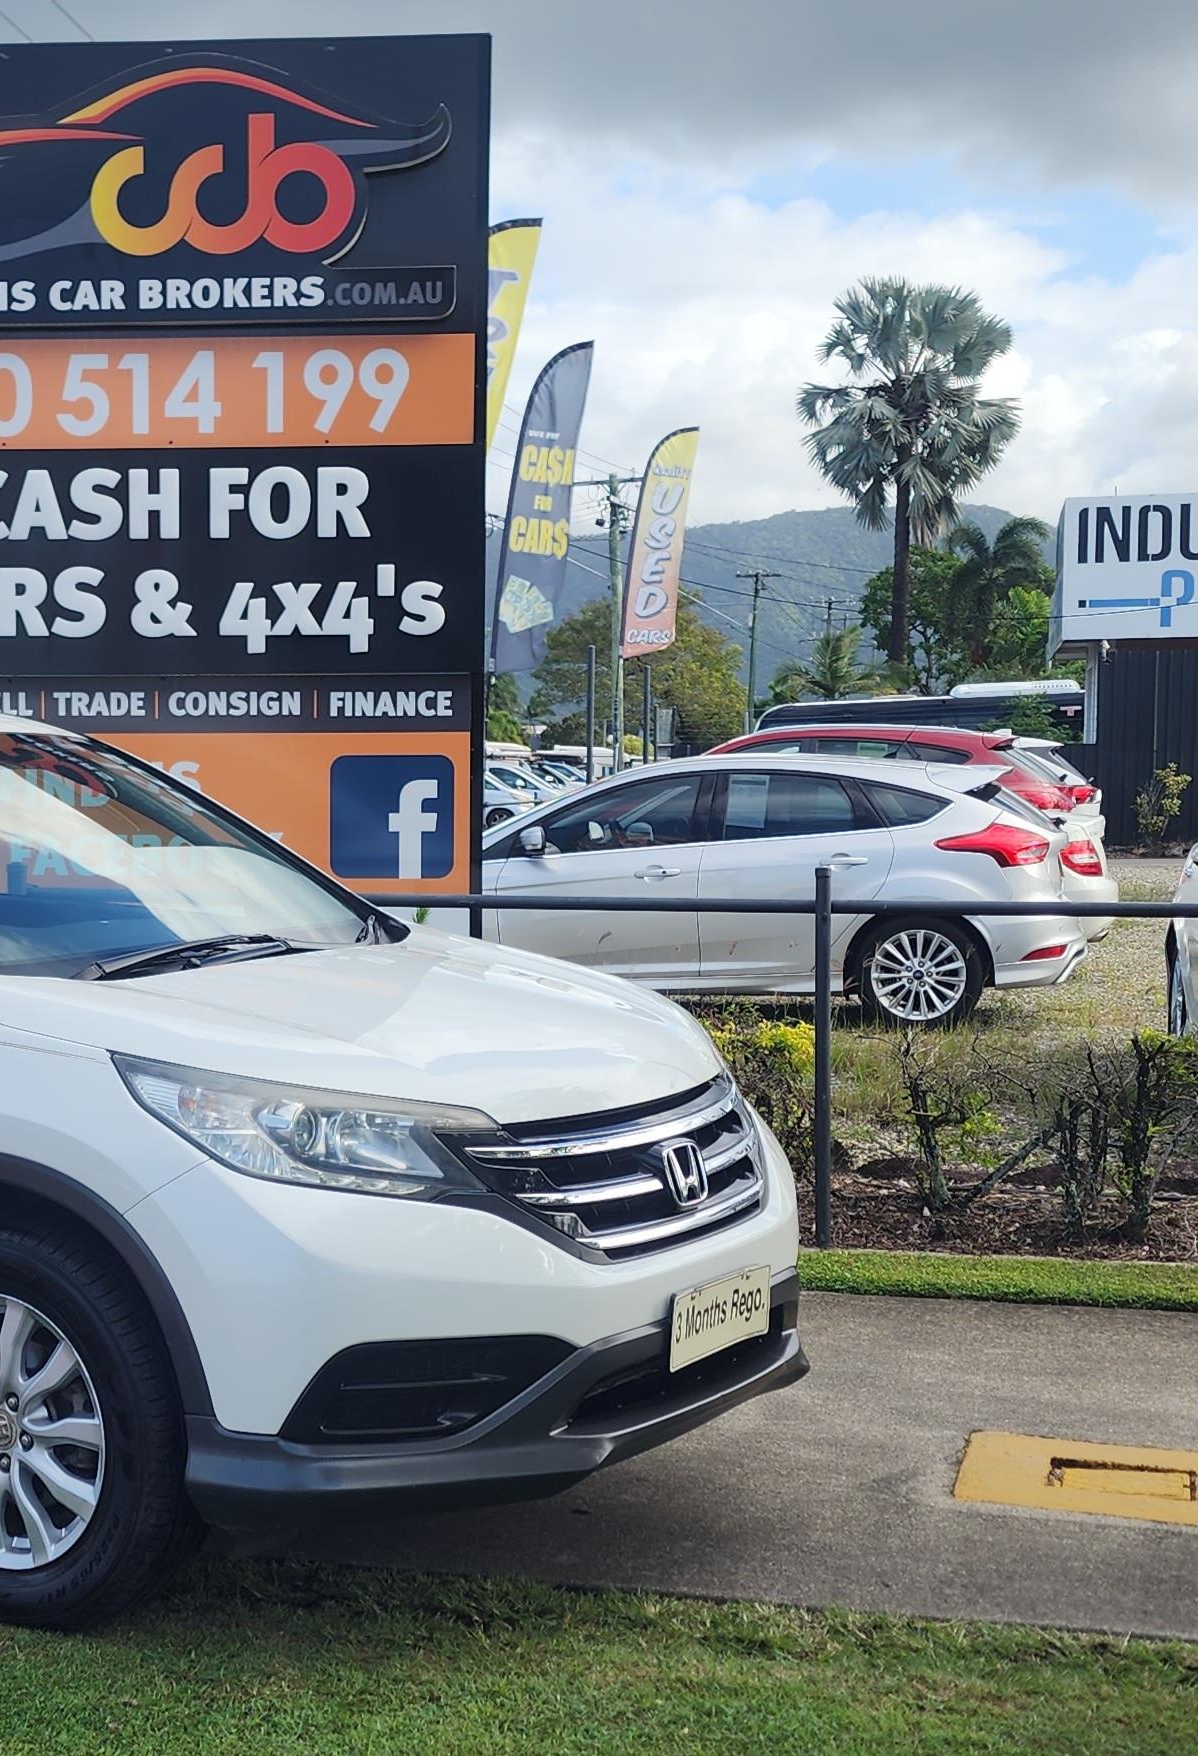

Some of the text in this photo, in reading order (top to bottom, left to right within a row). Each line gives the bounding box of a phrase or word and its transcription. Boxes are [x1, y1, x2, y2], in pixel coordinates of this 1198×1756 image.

[49, 280, 126, 311] CAR
[56, 351, 222, 437] 514
[252, 348, 410, 434] 199
[209, 466, 371, 540] FOR
[130, 569, 198, 638] &
[54, 691, 146, 718] TRADE
[168, 690, 301, 717] CONSIGN
[329, 690, 453, 718] FINANCE
[675, 1287, 765, 1344] 3 Months Rego.
